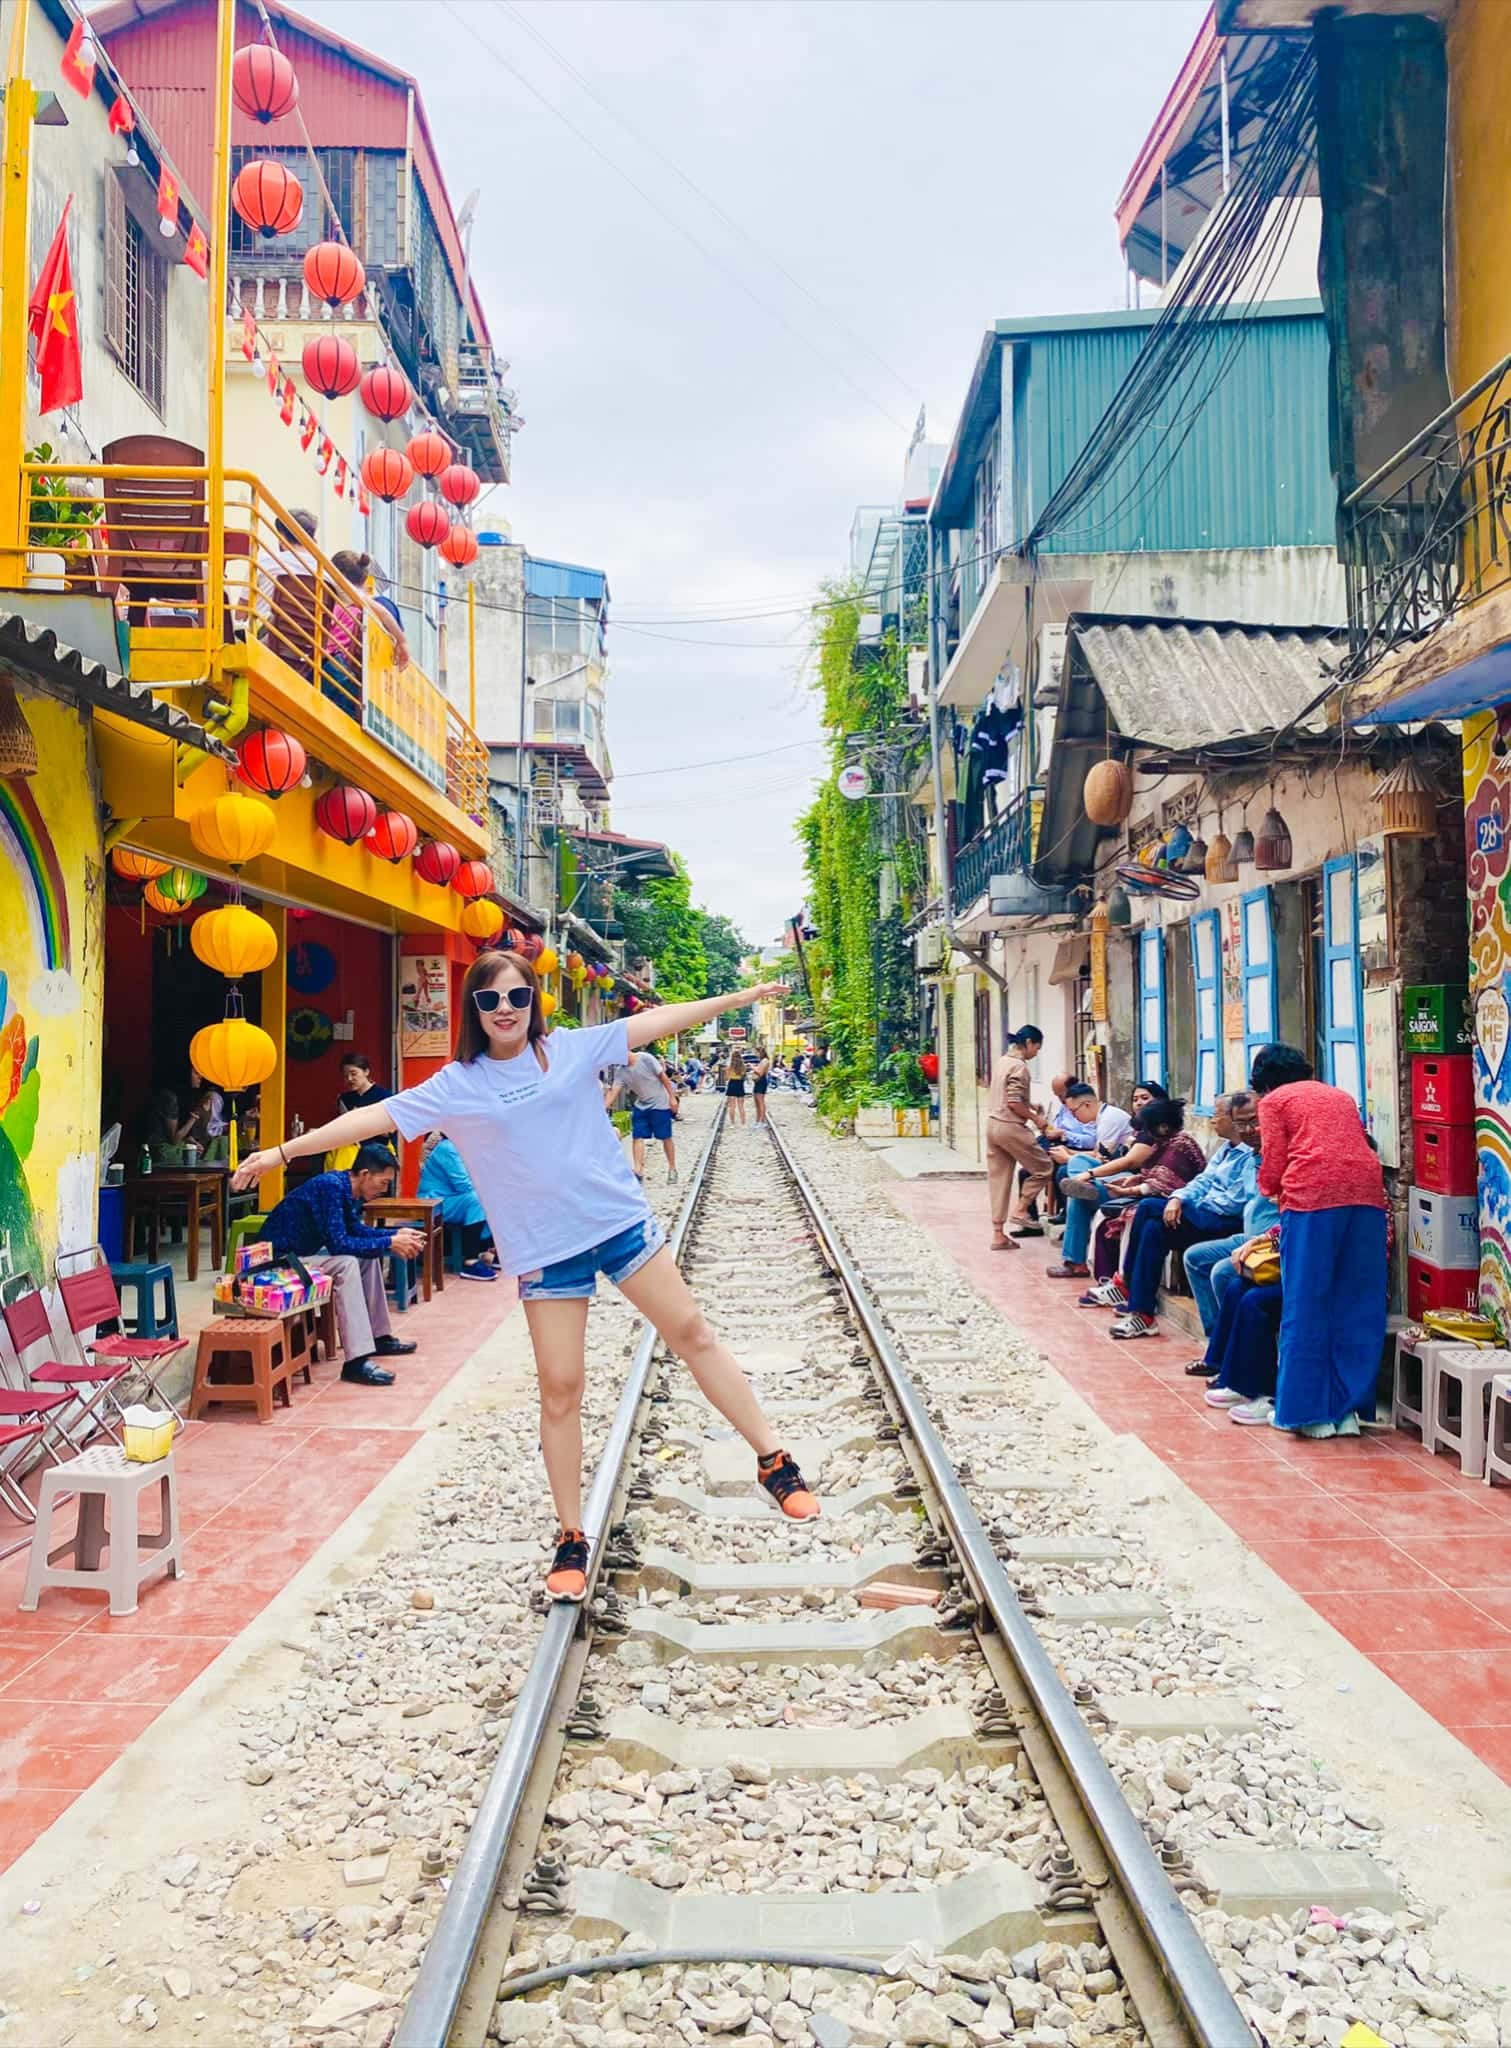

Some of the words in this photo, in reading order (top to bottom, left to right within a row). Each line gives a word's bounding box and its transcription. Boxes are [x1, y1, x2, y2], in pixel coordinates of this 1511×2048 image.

[1480, 819, 1497, 849] 28
[1481, 1004, 1505, 1022] TAKE
[1408, 1020, 1439, 1033] SAIGON
[1482, 1024, 1503, 1042] ME
